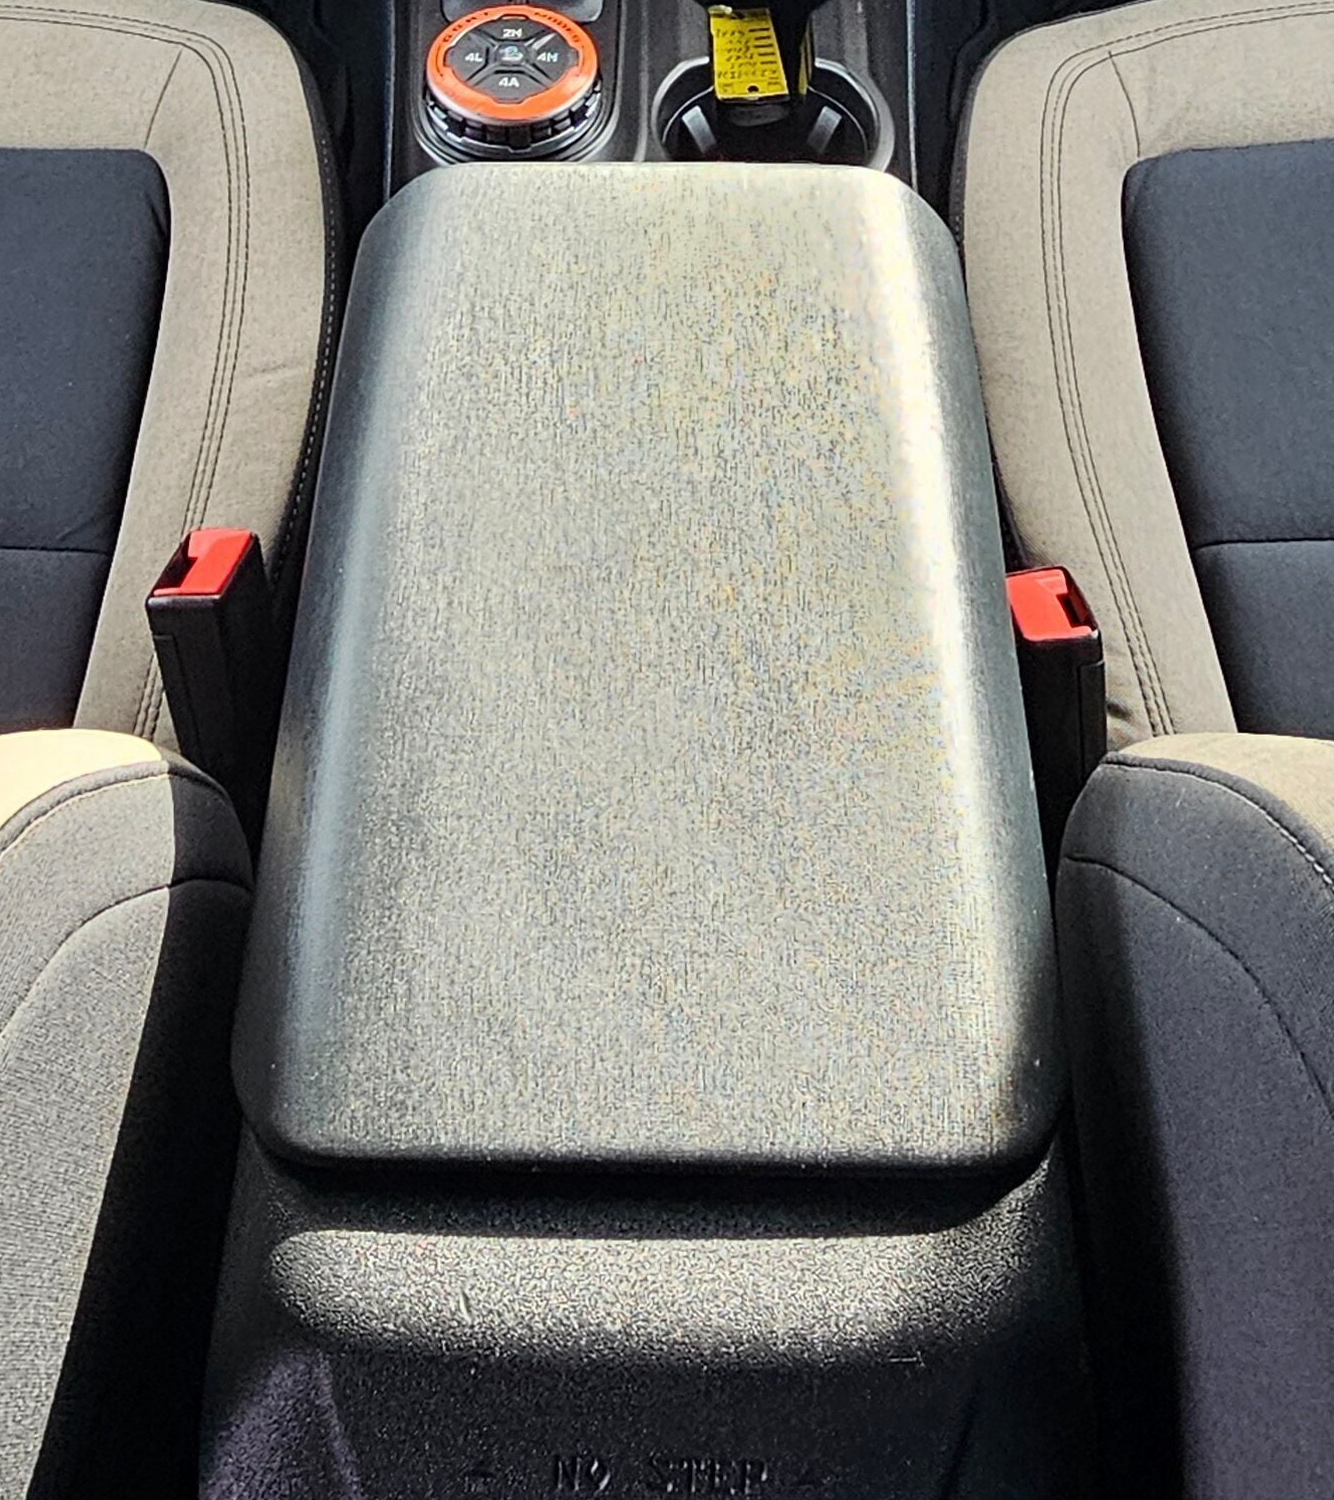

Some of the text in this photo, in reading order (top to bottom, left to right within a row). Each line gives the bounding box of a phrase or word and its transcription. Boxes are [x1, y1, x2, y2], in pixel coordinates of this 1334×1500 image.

[465, 52, 484, 62] 4L
[537, 52, 558, 62] 4H
[499, 77, 520, 88] 4A
